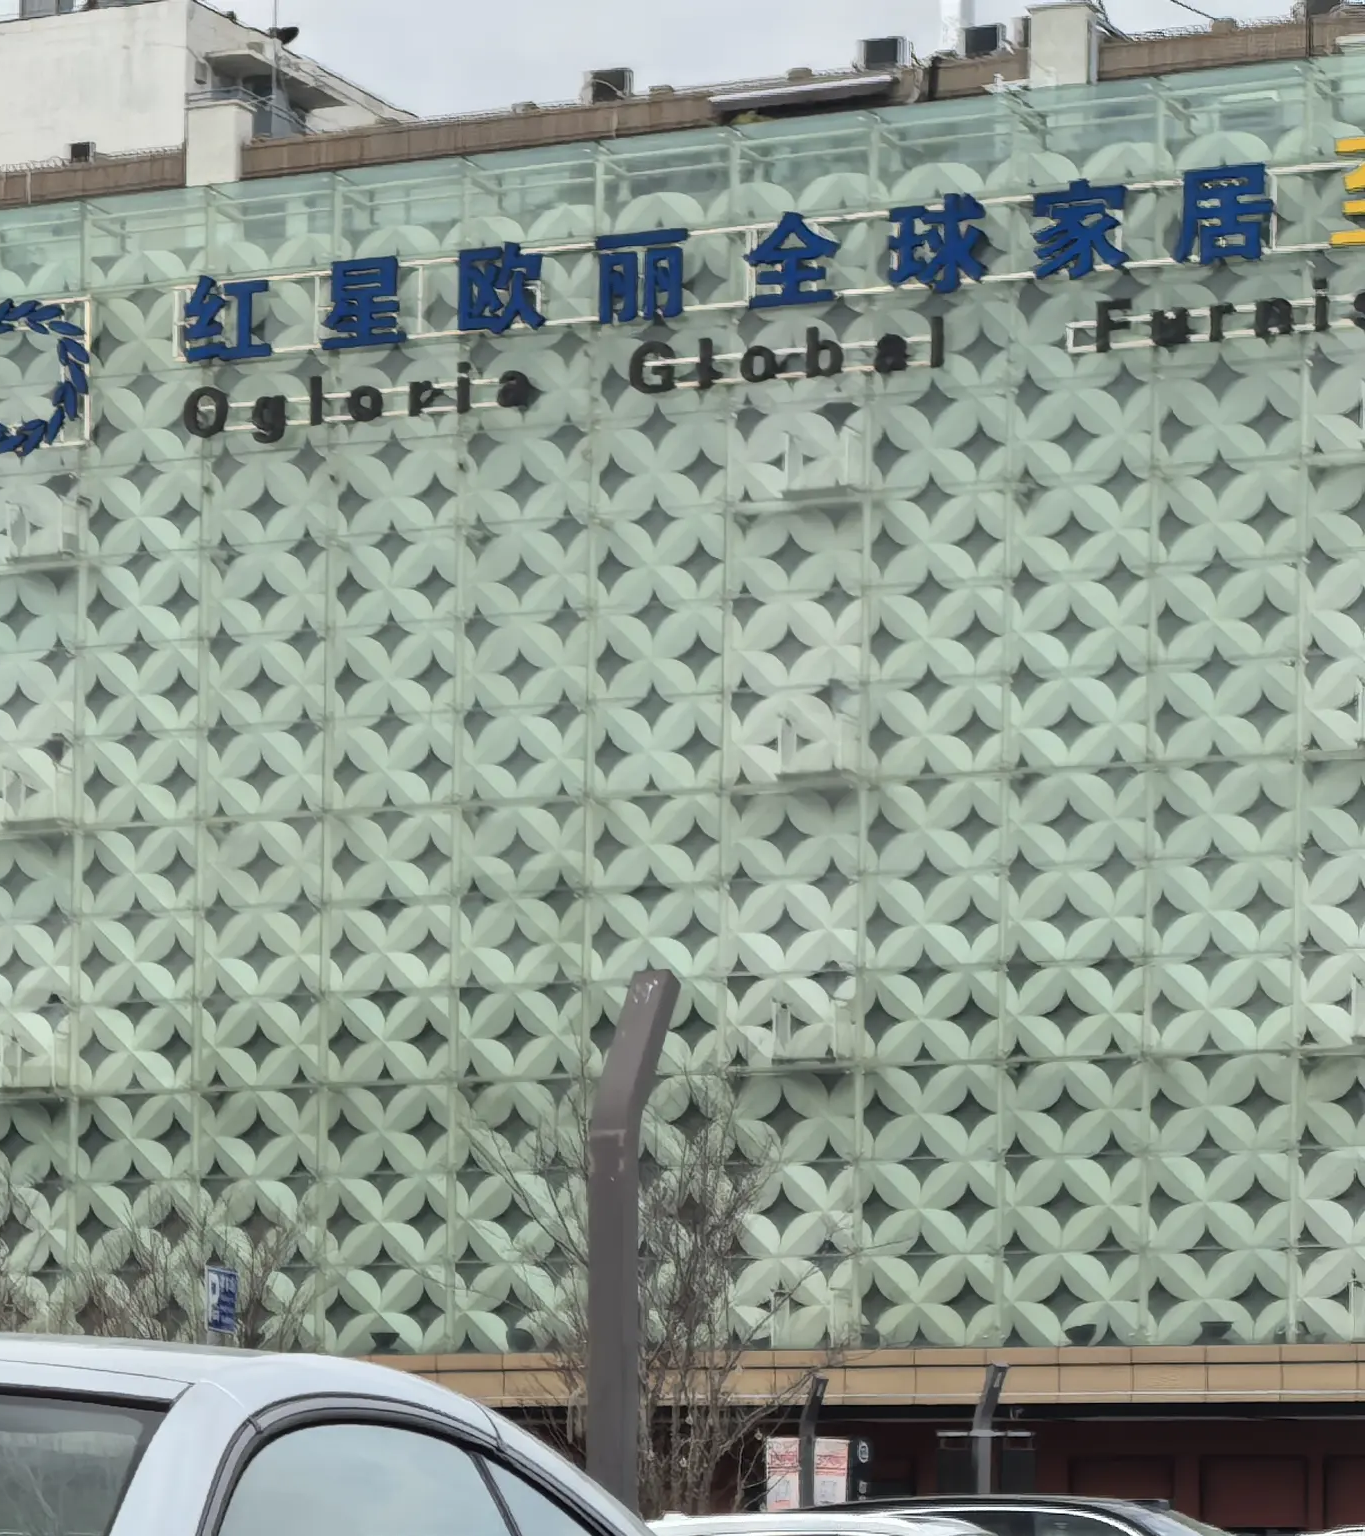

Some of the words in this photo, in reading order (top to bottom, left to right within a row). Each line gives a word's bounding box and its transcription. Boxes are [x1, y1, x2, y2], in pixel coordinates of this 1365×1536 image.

[183, 162, 1276, 362] 红星欧丽全球家居
[183, 362, 531, 443] Ogloria
[629, 316, 945, 395] Global
